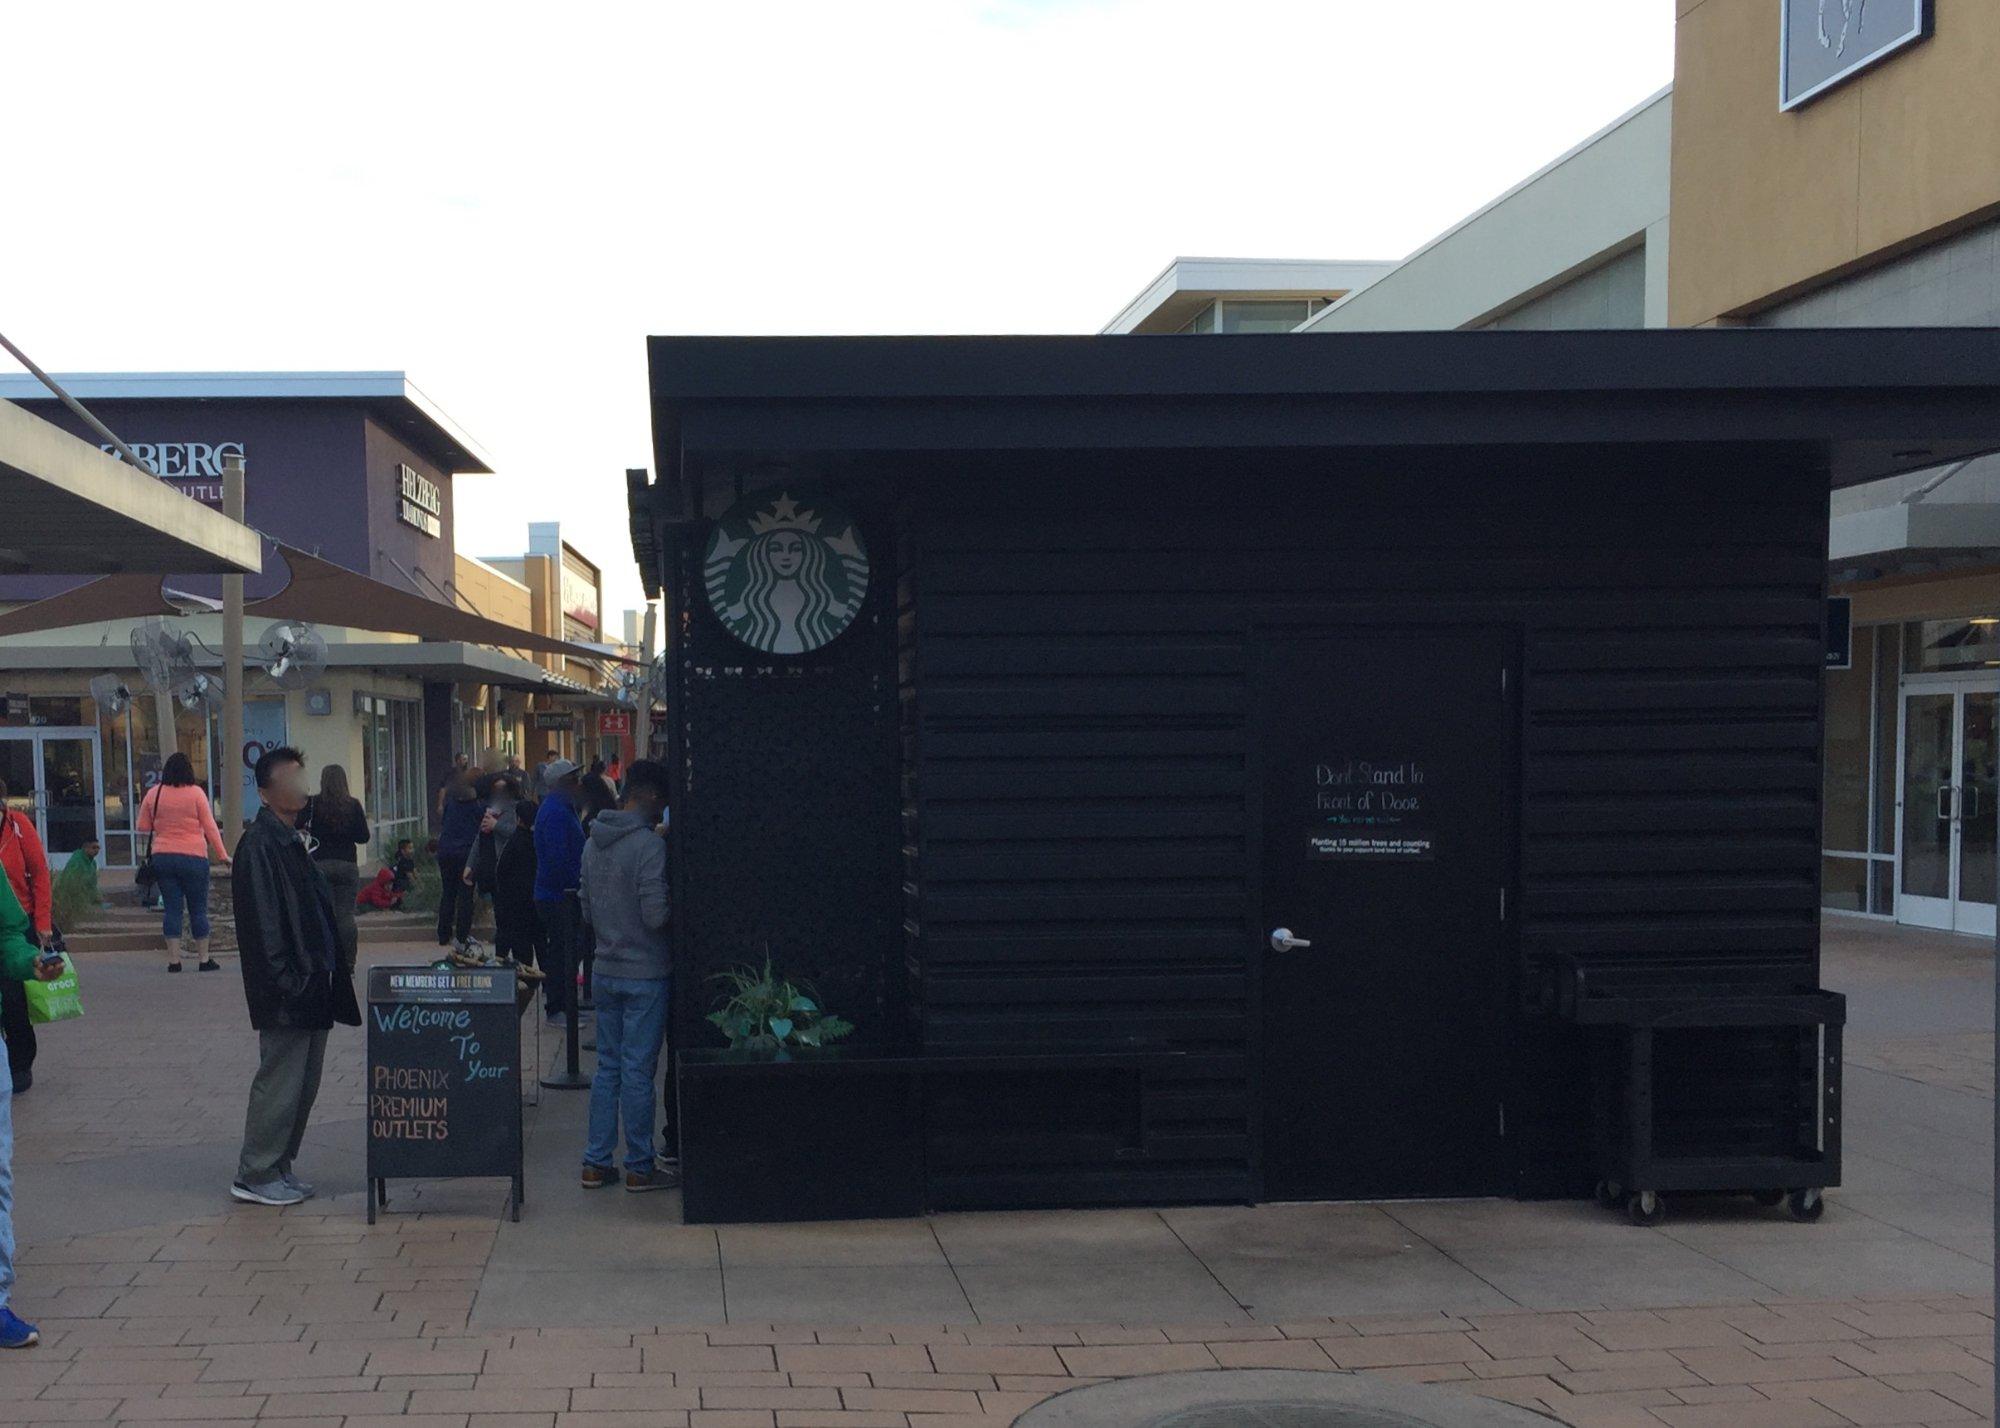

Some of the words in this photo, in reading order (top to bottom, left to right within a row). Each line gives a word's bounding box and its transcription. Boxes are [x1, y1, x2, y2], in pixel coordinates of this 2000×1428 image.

[173, 485, 224, 500] UTL
[401, 463, 441, 517] HELZBERG
[1357, 791, 1374, 810] of
[390, 975, 405, 988] NEW
[405, 975, 437, 989] MEMBERS
[437, 976, 450, 989] GET
[456, 976, 472, 988] FREE
[374, 1004, 472, 1034] Welcome
[450, 1032, 481, 1060] To
[374, 1065, 450, 1091] PHOENIX
[371, 1096, 448, 1118] PREMIUM
[373, 1119, 449, 1141] OUTLETS
